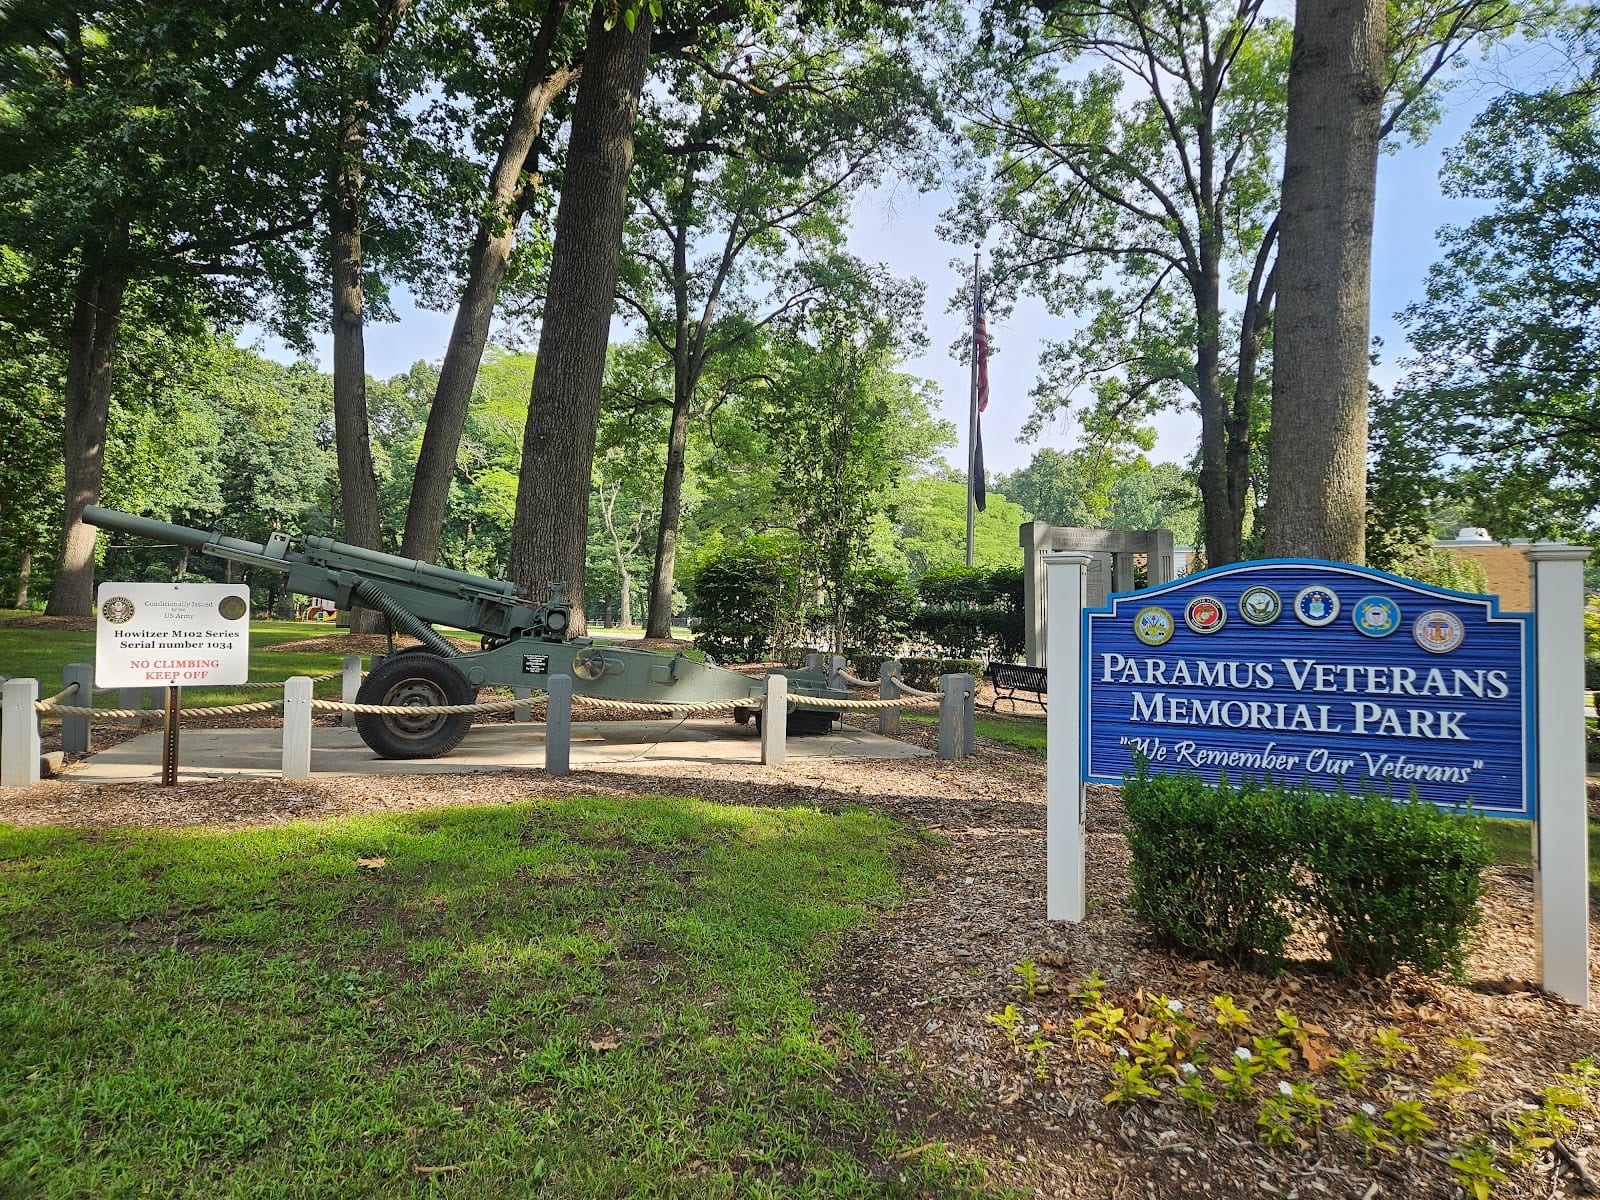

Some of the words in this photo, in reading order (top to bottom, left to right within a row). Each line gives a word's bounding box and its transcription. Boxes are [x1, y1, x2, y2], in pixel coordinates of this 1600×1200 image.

[144, 600, 190, 608] Conditionally
[114, 630, 169, 638] Howitzer
[171, 630, 203, 638] M102
[205, 630, 240, 638] Series
[120, 640, 155, 649] Serial
[159, 640, 204, 649] number
[207, 642, 233, 650] 1034
[130, 660, 150, 669] NO
[153, 659, 220, 669] CLIMBING
[145, 671, 180, 680] KEEP
[183, 671, 209, 679] OFF
[1100, 652, 1275, 690] PARAMUS
[1280, 658, 1510, 699] VETERANS
[1130, 691, 1342, 734] MEMORIAL
[1351, 701, 1471, 741] PARK
[1173, 739, 1300, 772] Remember
[1305, 748, 1355, 775] Our
[1360, 751, 1484, 784] Veterans"
